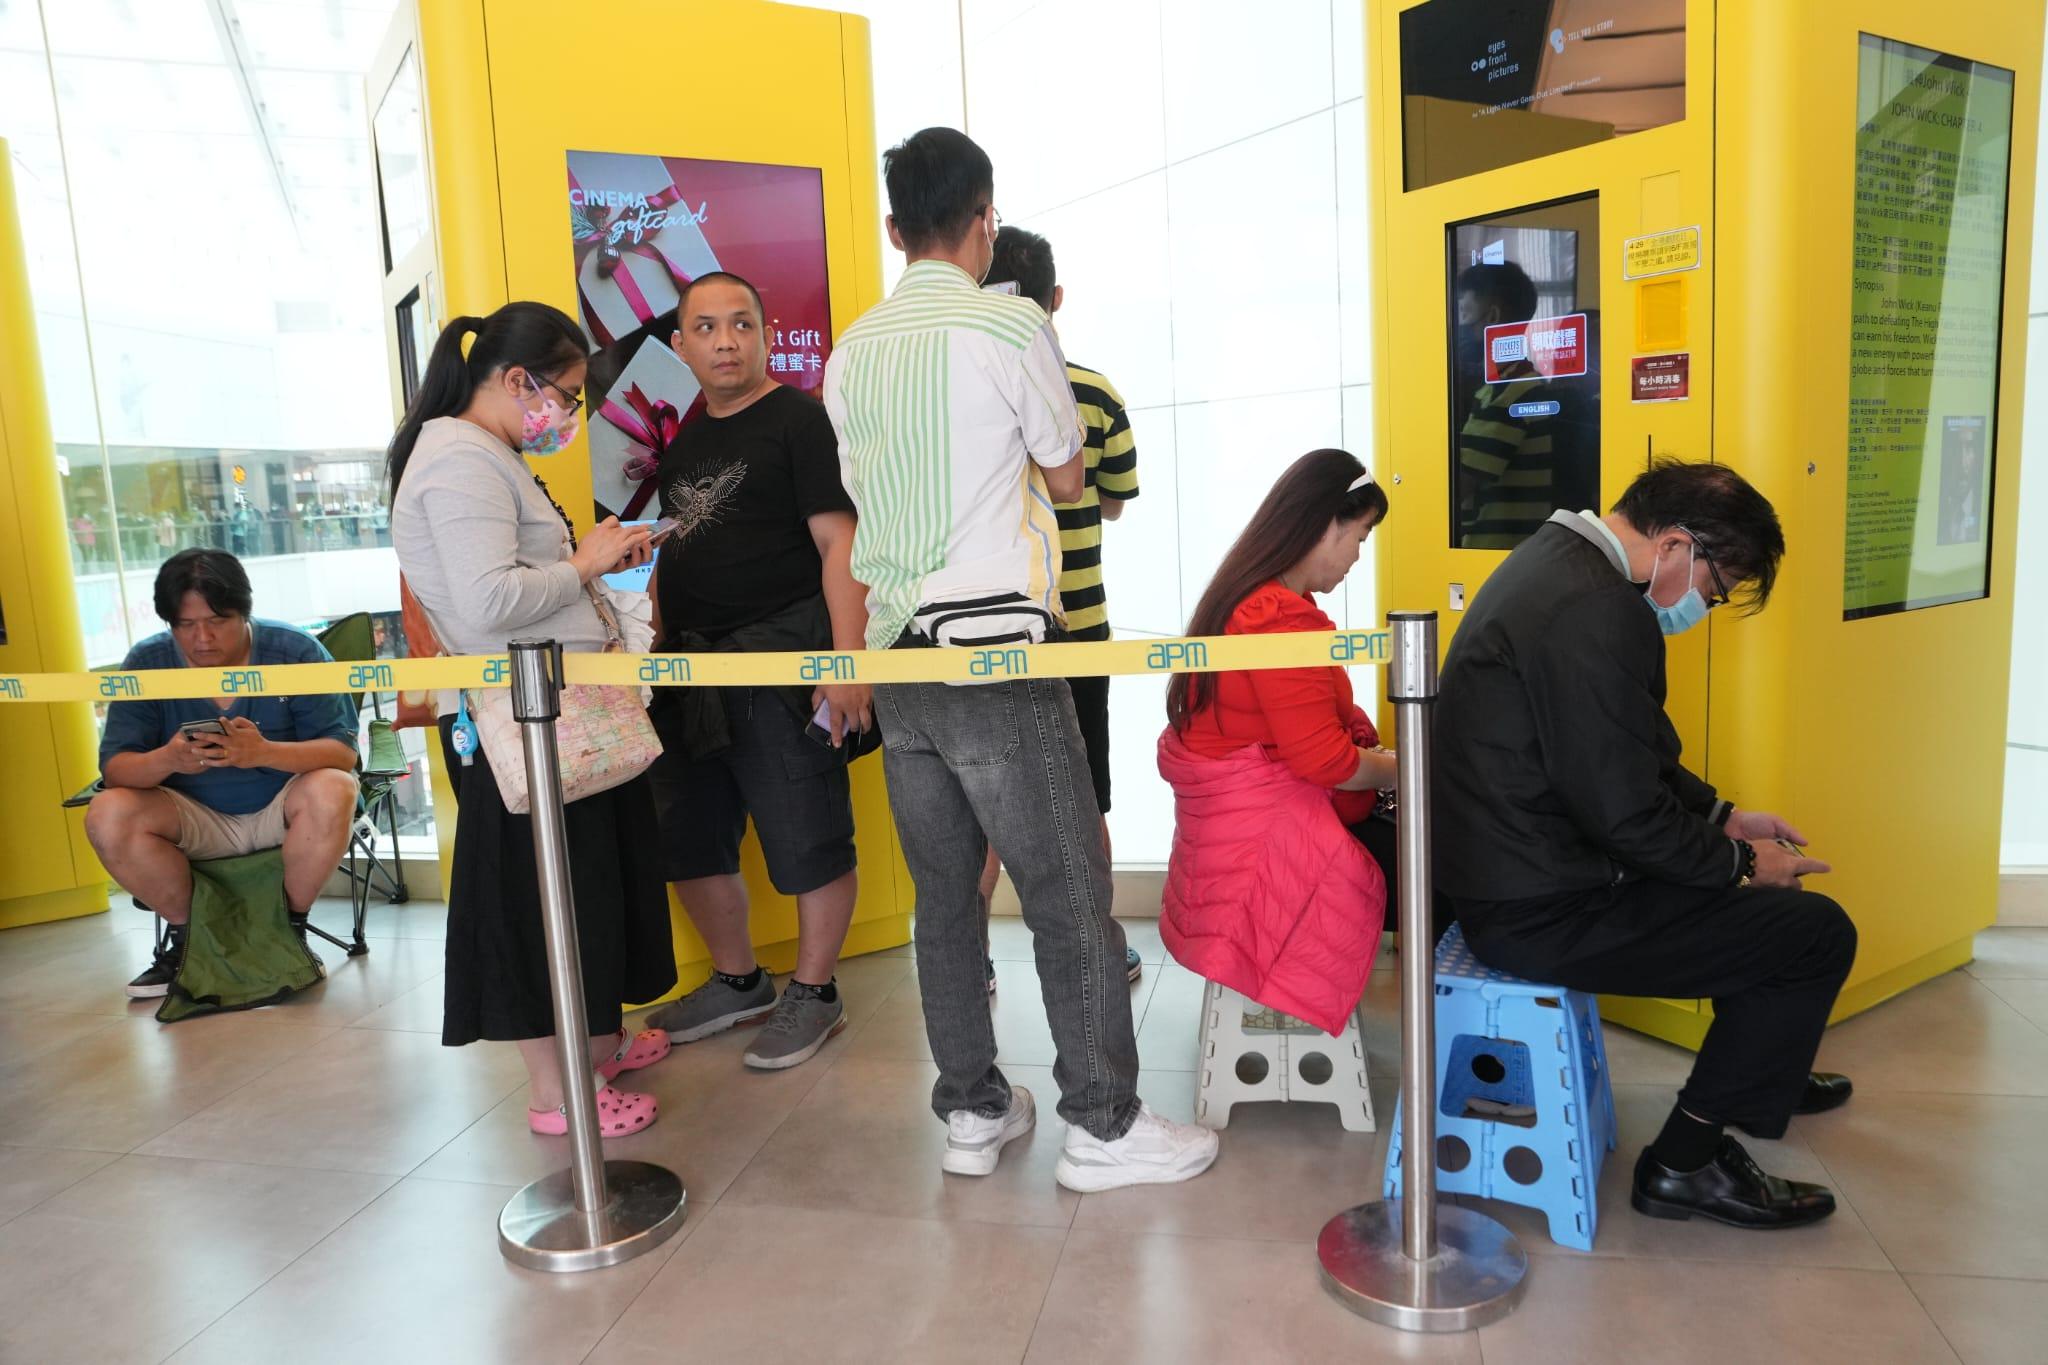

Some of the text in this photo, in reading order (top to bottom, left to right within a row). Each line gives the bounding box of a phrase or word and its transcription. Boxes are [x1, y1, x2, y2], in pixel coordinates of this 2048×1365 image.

[1488, 40, 1506, 54] eyes
[1488, 52, 1507, 67] front
[1488, 64, 1519, 83] pictures
[1502, 99, 1520, 110] Never
[1520, 94, 1535, 104] Goes
[1536, 90, 1549, 100] Out
[1891, 103, 1915, 119] JOHN
[569, 188, 649, 209] CINEMA
[611, 201, 708, 244] giftcard
[1854, 277, 1885, 293] Synopsis
[1881, 297, 1897, 309] John
[1898, 298, 1914, 310] Wick
[1853, 314, 1870, 326] path
[1870, 314, 1879, 325] to
[1879, 313, 1910, 330] defeating
[1911, 316, 1923, 328] The
[789, 329, 821, 346] Gift
[1499, 340, 1520, 352] TICKETS
[770, 352, 822, 372] 禮蜜卡
[1852, 363, 1871, 378] globe
[1518, 404, 1550, 414] ENGLISH
[969, 649, 1028, 675] apm
[1147, 642, 1208, 669] apm
[483, 659, 511, 683] ap
[639, 657, 692, 682] apm
[800, 655, 856, 680] apm
